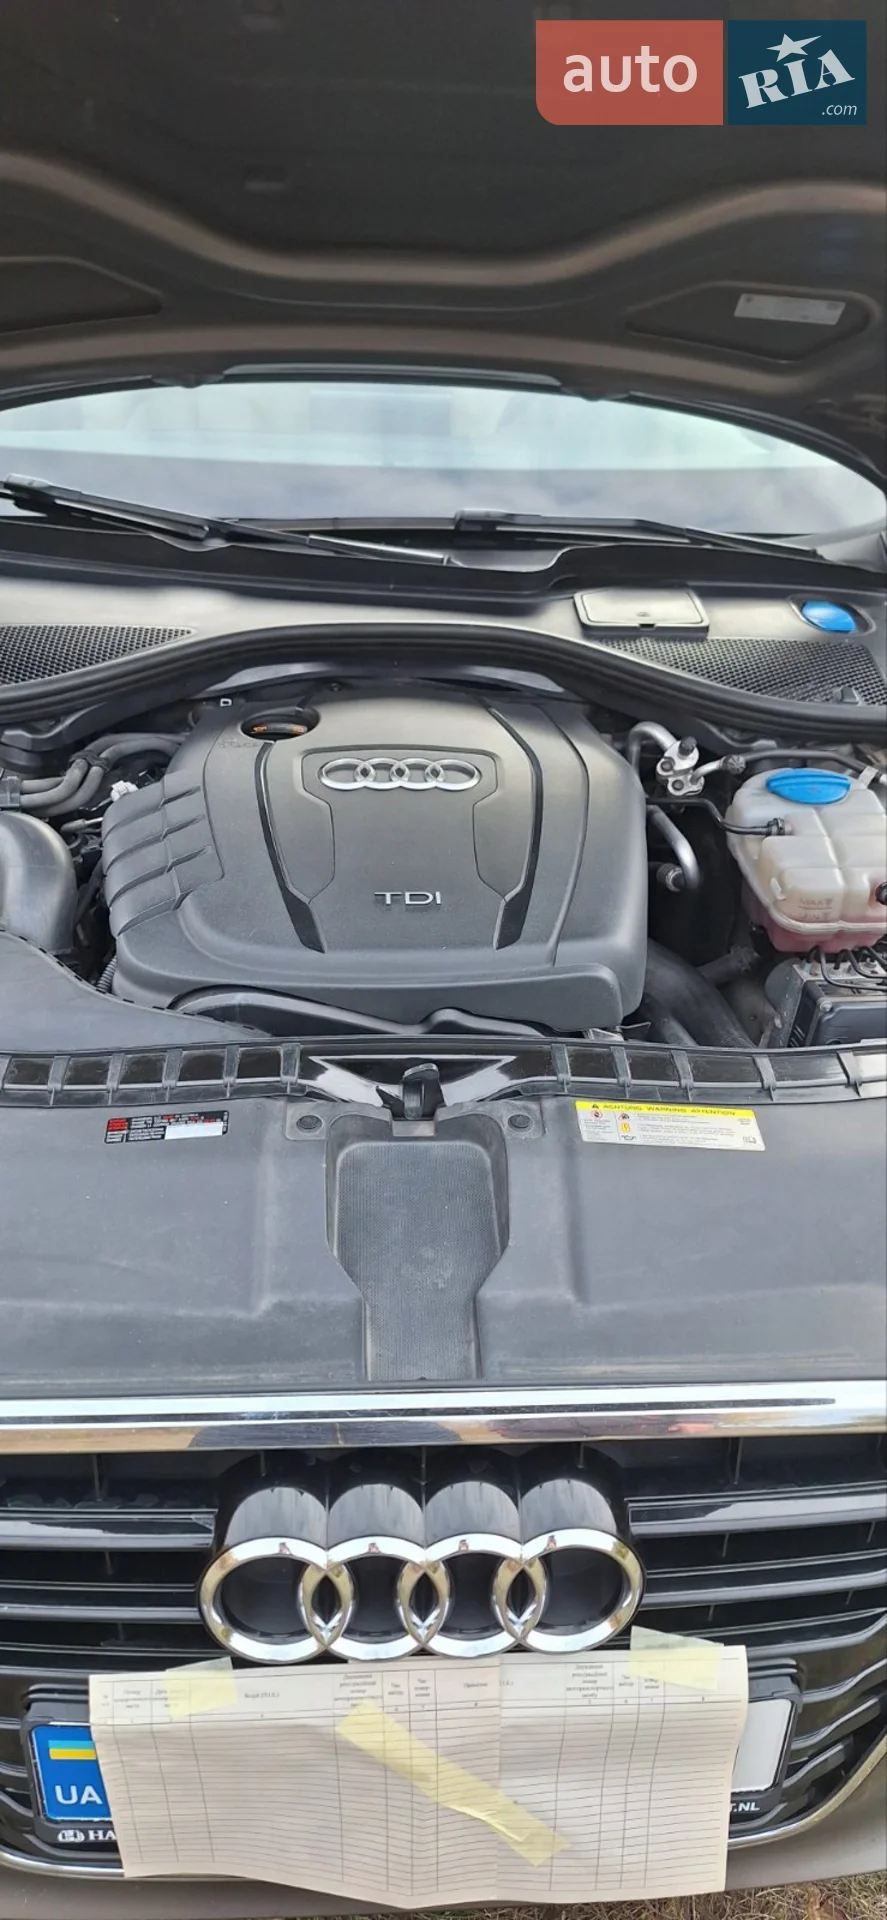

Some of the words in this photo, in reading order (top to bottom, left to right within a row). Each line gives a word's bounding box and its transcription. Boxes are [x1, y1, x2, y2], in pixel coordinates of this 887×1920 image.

[374, 891, 441, 906] TDI
[603, 1104, 643, 1112] ACHTUNG
[691, 1108, 736, 1116] ATTENTION
[55, 1785, 103, 1805] UA
